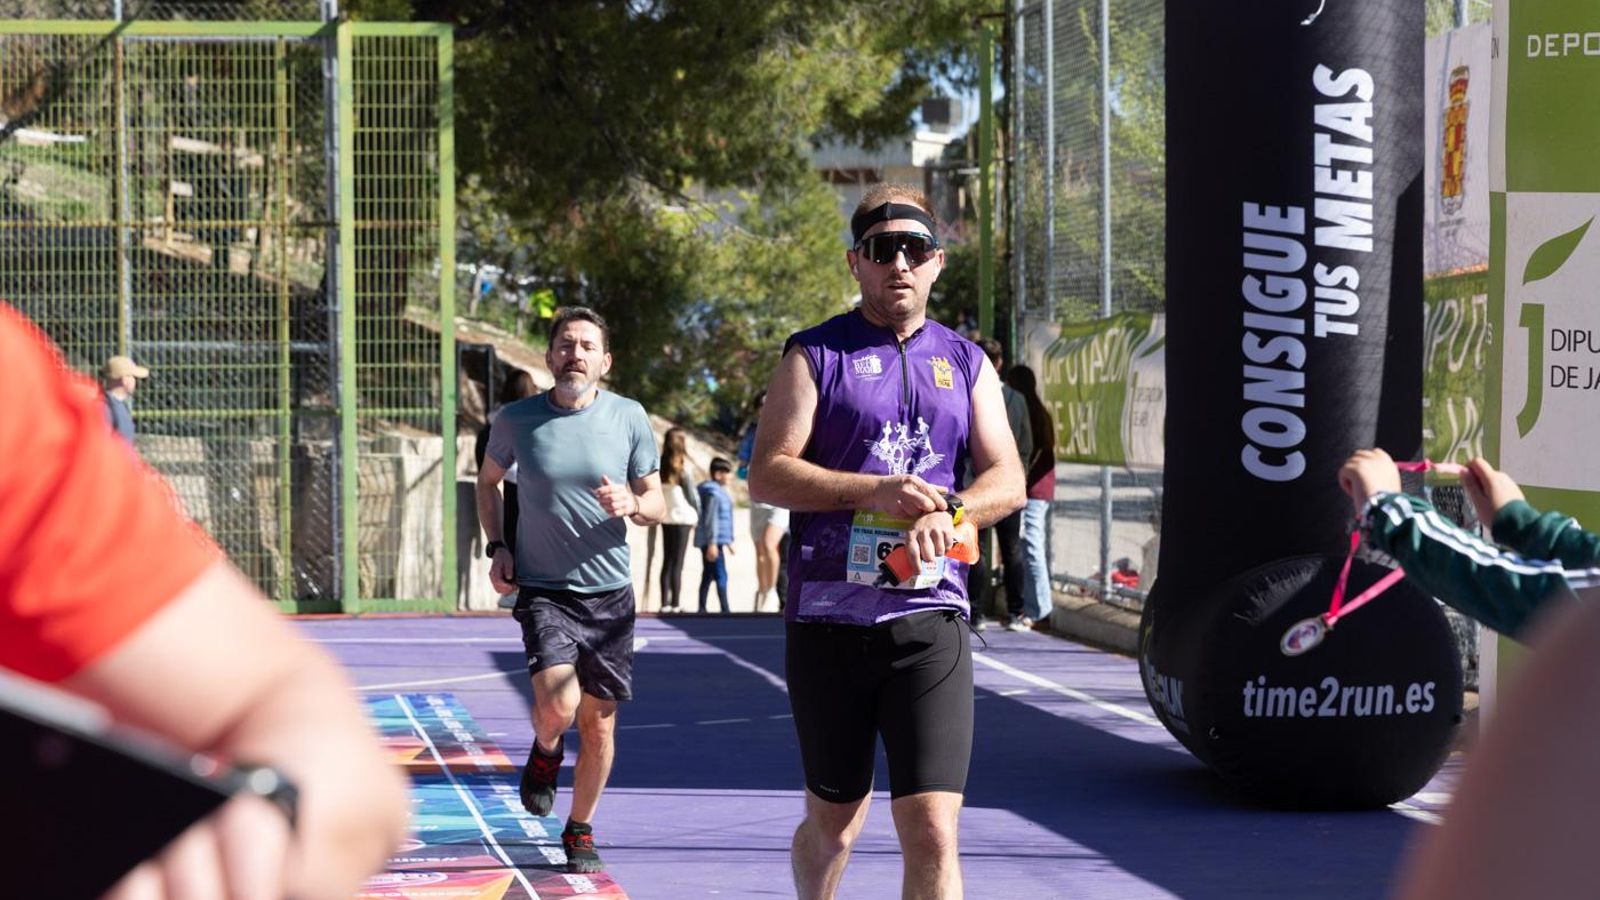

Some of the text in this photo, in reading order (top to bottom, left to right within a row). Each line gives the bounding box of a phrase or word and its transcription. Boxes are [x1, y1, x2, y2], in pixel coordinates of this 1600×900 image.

[1312, 63, 1375, 338] TUS METAS
[1241, 202, 1307, 482] CONSIGUE
[1550, 365, 1579, 389] DE
[1242, 675, 1436, 718] time2run.es
